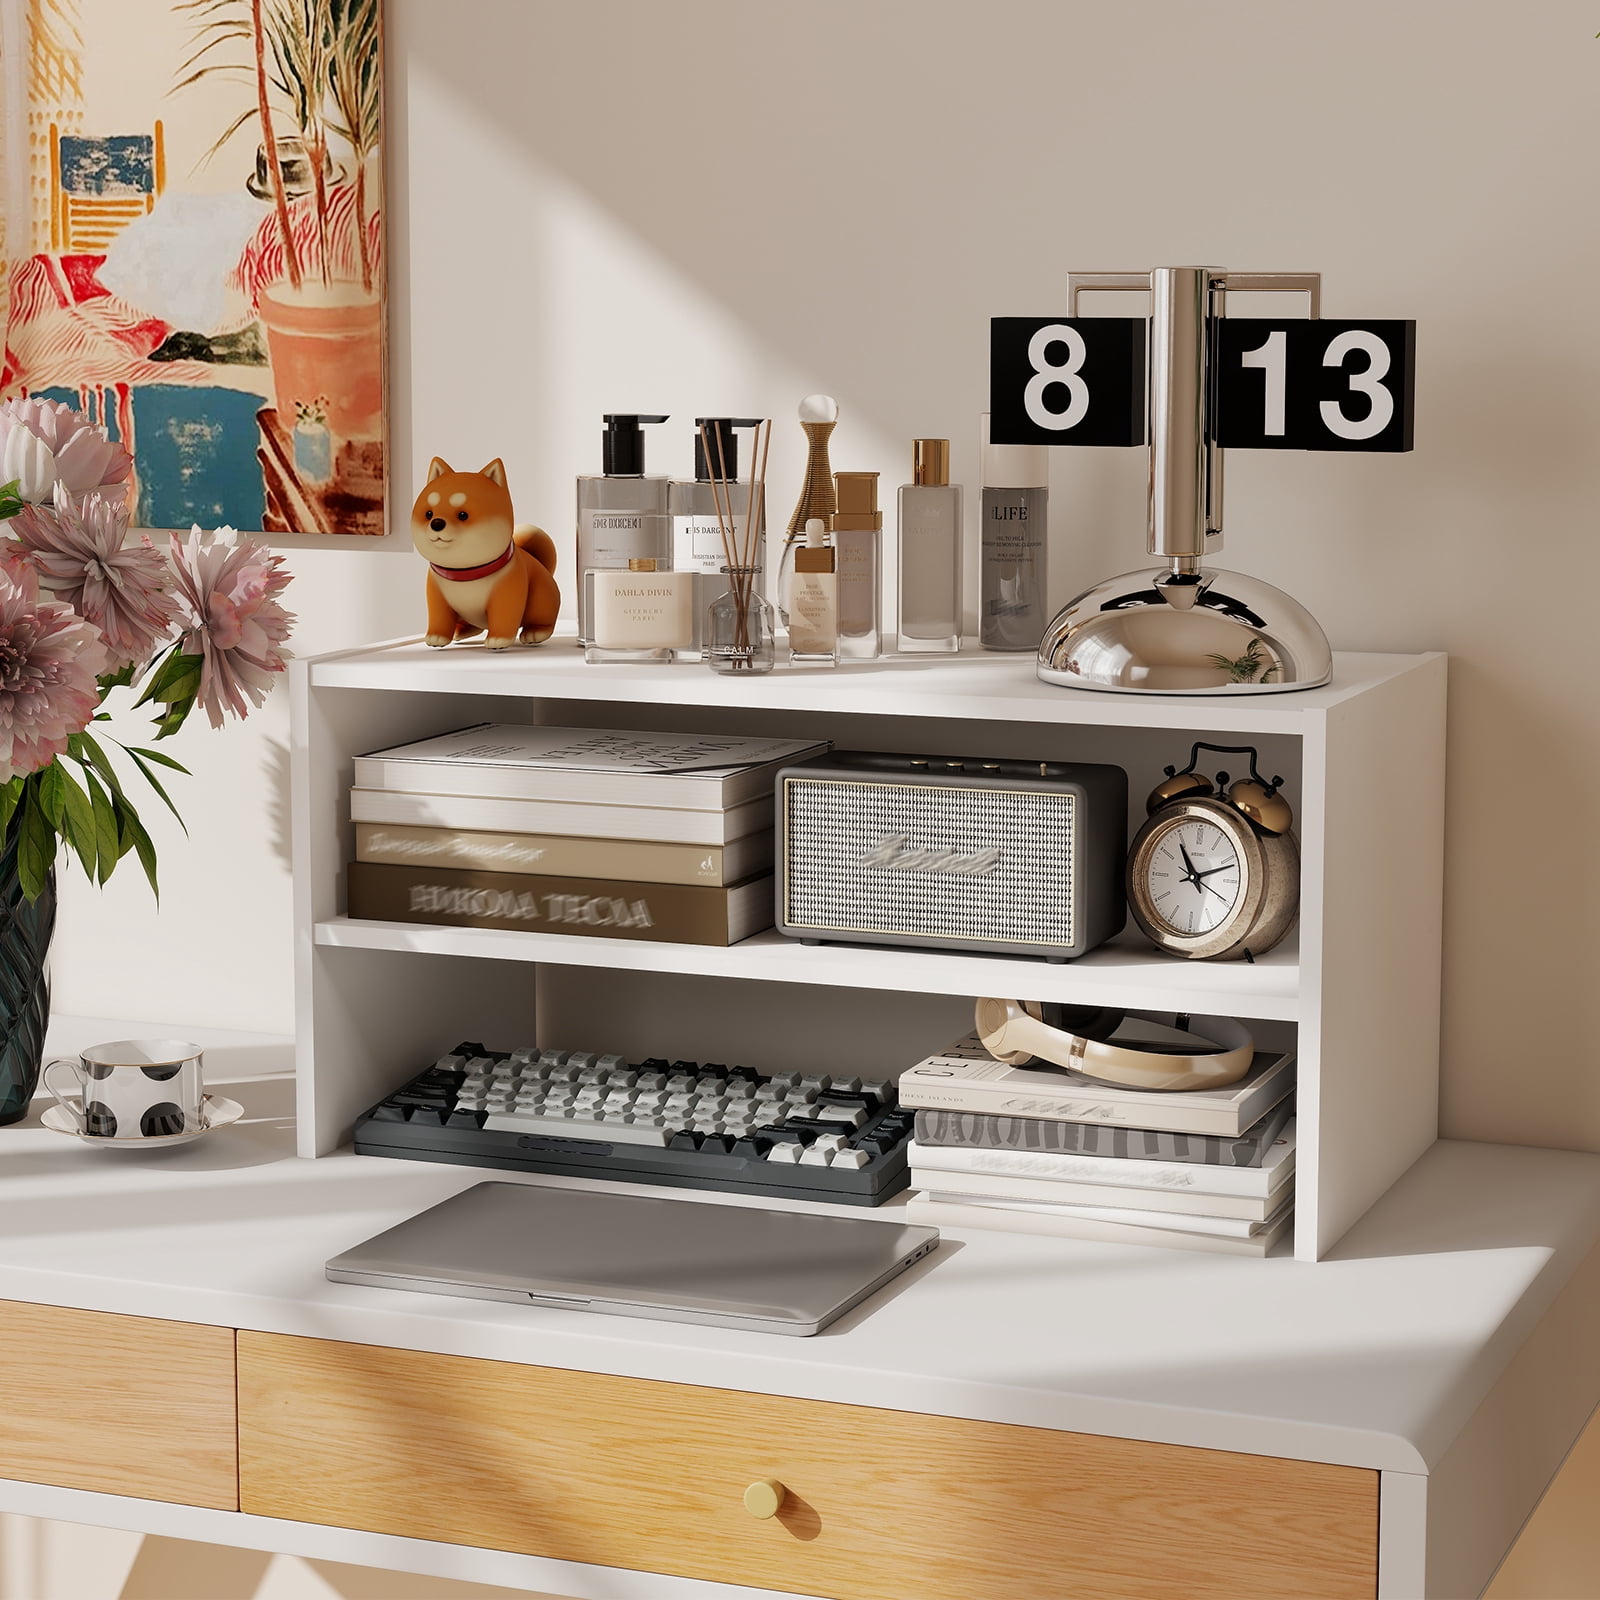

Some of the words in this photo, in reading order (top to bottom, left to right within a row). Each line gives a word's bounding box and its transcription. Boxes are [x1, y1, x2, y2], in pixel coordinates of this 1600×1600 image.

[1023, 323, 1090, 431] 8
[1241, 328, 1395, 441] 13
[994, 506, 1028, 521] LIFE
[615, 588, 645, 597] DAHLA
[647, 588, 673, 597] DIVIN
[724, 645, 755, 655] CALM
